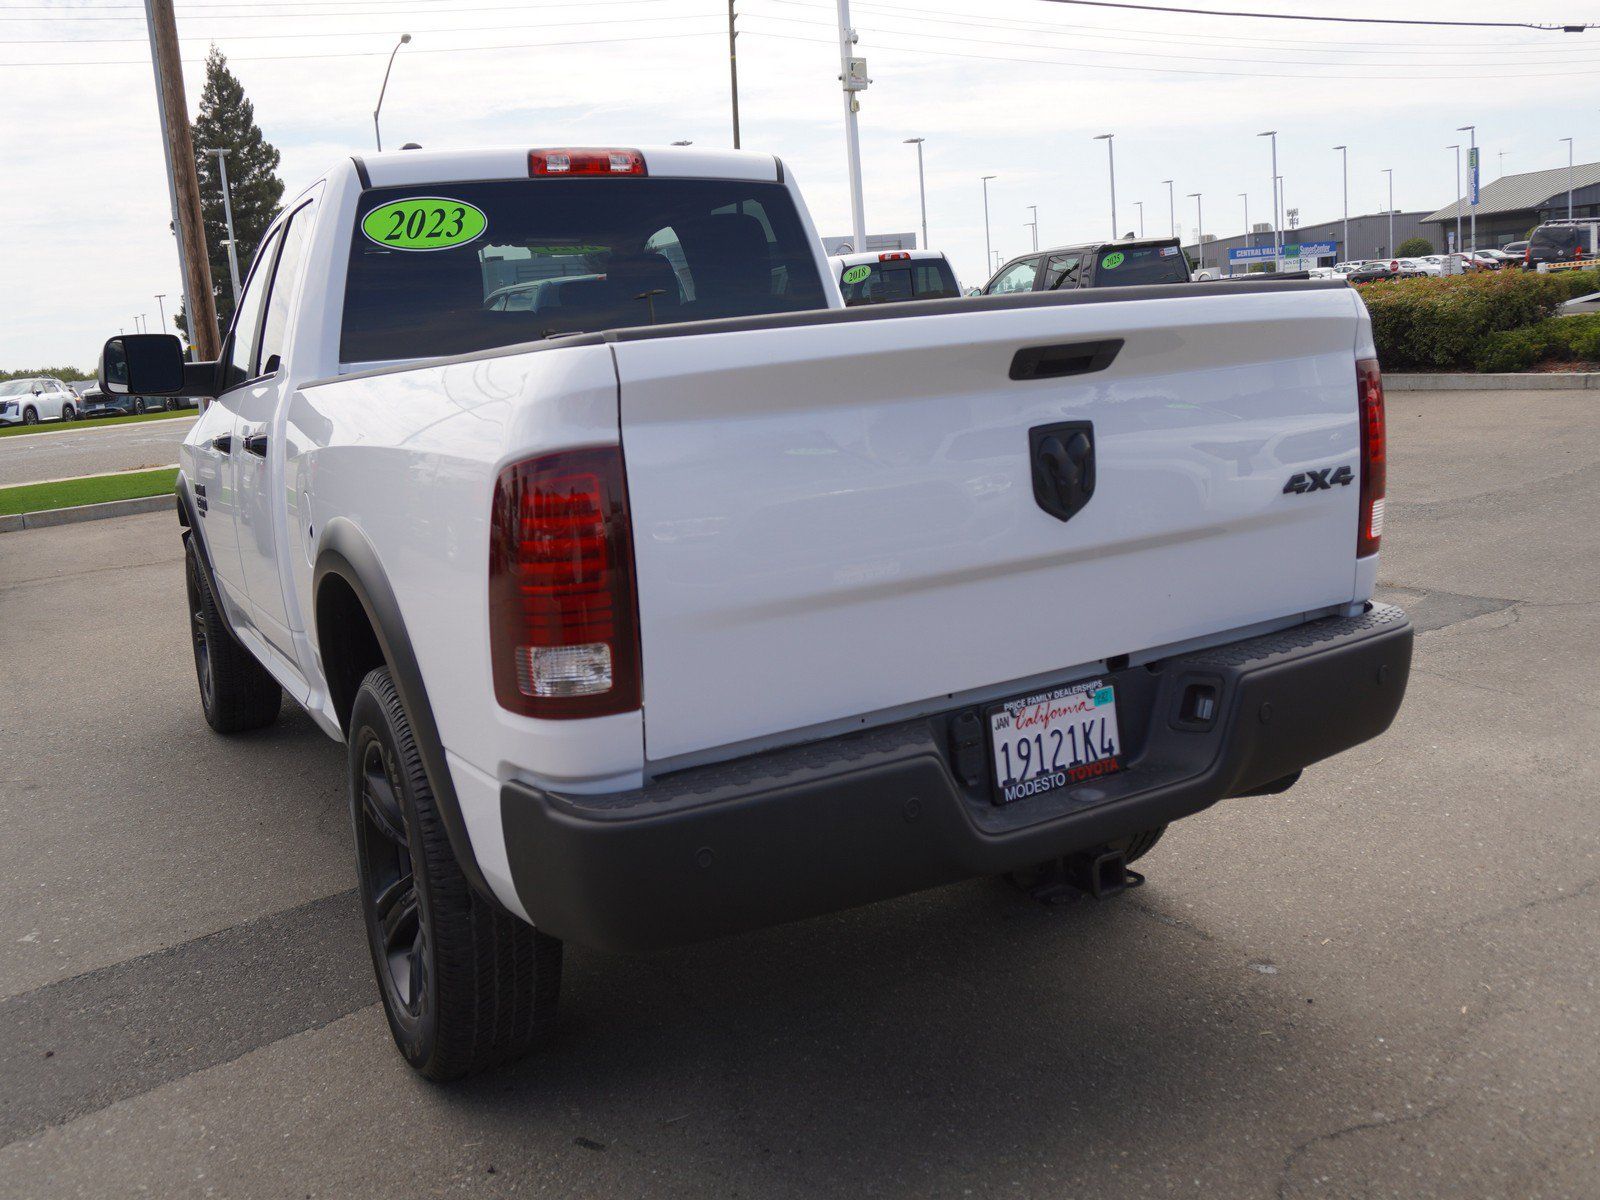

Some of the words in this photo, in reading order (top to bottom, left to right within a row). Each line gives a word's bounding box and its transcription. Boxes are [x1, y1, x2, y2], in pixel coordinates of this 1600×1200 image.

[384, 208, 466, 241] 2023
[1106, 253, 1121, 267] 2025
[1236, 249, 1261, 257] CENTRAL
[1263, 247, 1283, 255] VALLY
[848, 267, 867, 282] 2018
[1282, 465, 1355, 494] 4X4
[1004, 700, 1027, 714] PRICE
[1027, 691, 1053, 706] FAMILY
[1053, 680, 1103, 699] DEALERSHIPS
[995, 716, 1010, 731] JAN
[1015, 698, 1096, 730] California
[1001, 717, 1115, 787] 19121K4
[1004, 772, 1066, 802] MODESTO
[1067, 757, 1119, 781] TOYOTA
